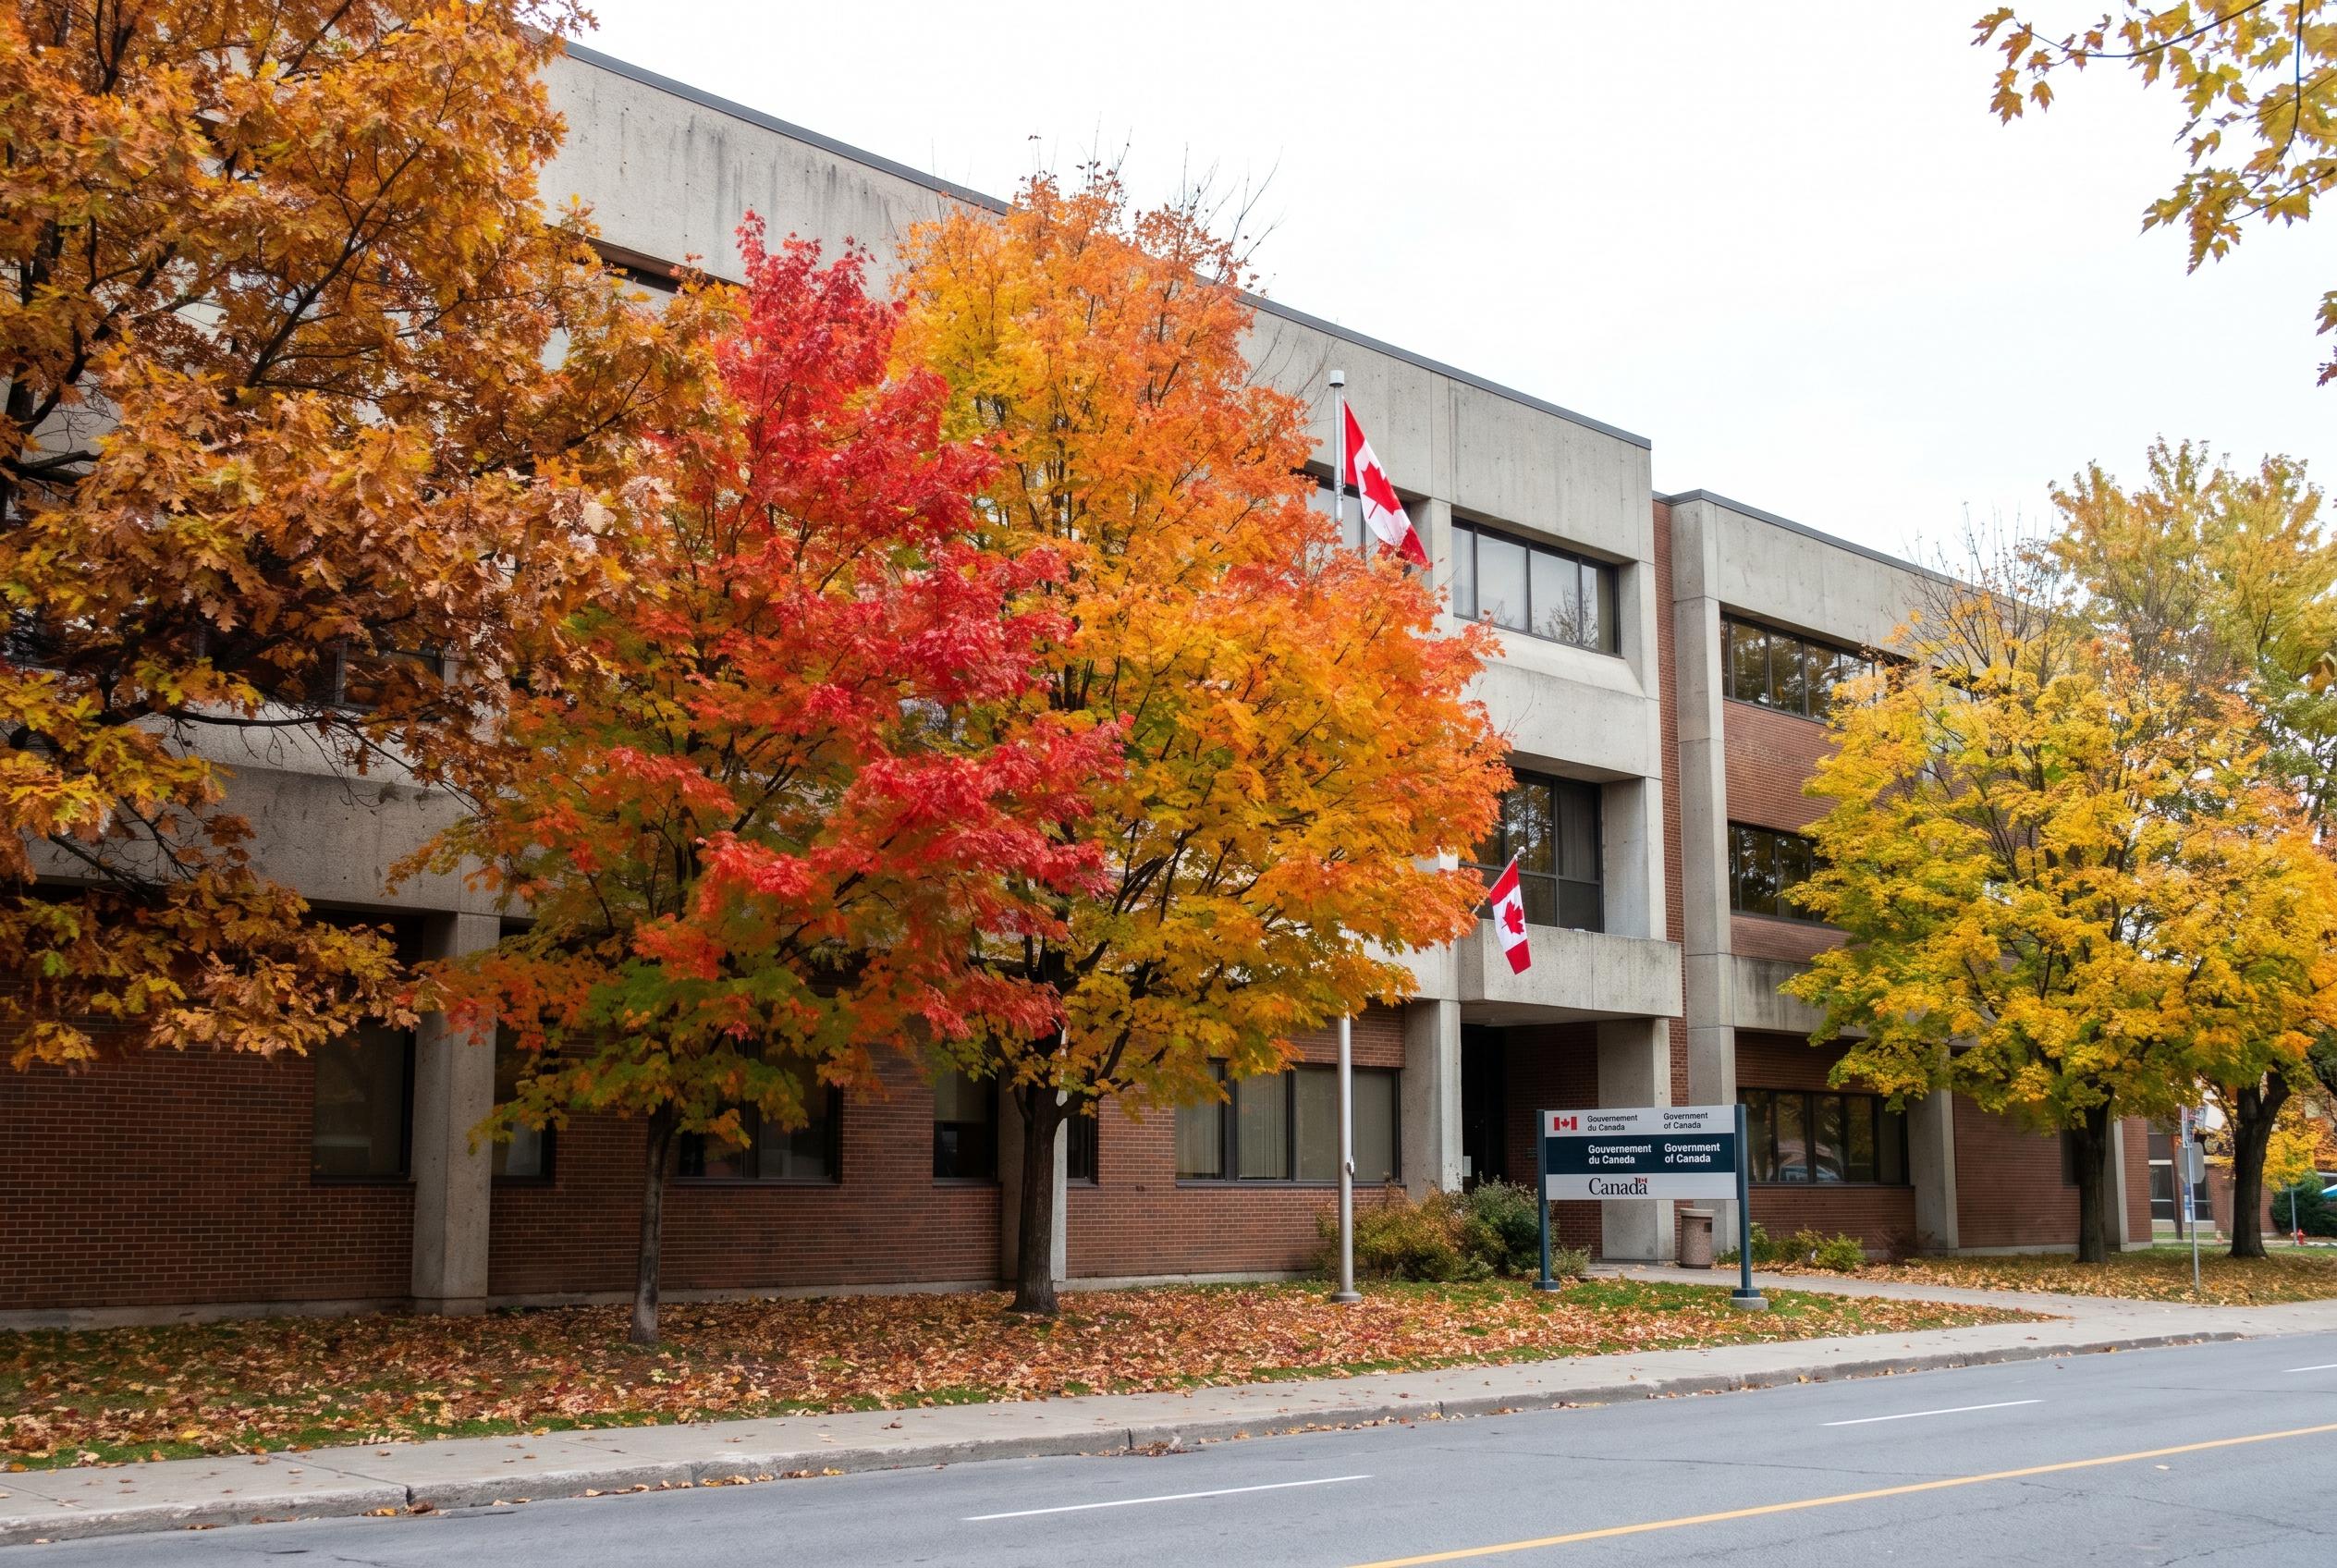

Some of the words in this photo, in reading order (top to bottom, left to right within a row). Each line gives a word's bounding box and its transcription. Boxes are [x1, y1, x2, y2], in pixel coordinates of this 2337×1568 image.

[1587, 1114, 1638, 1122] Gouvernement
[1663, 1112, 1708, 1121] Government
[1598, 1123, 1625, 1132] Canada
[1588, 1144, 1652, 1154] Gouvernement
[1664, 1143, 1720, 1153] Government
[1588, 1155, 1600, 1164] du
[1664, 1154, 1674, 1163] of
[1676, 1153, 1711, 1163] Canada
[1588, 1177, 1648, 1195] Canada
